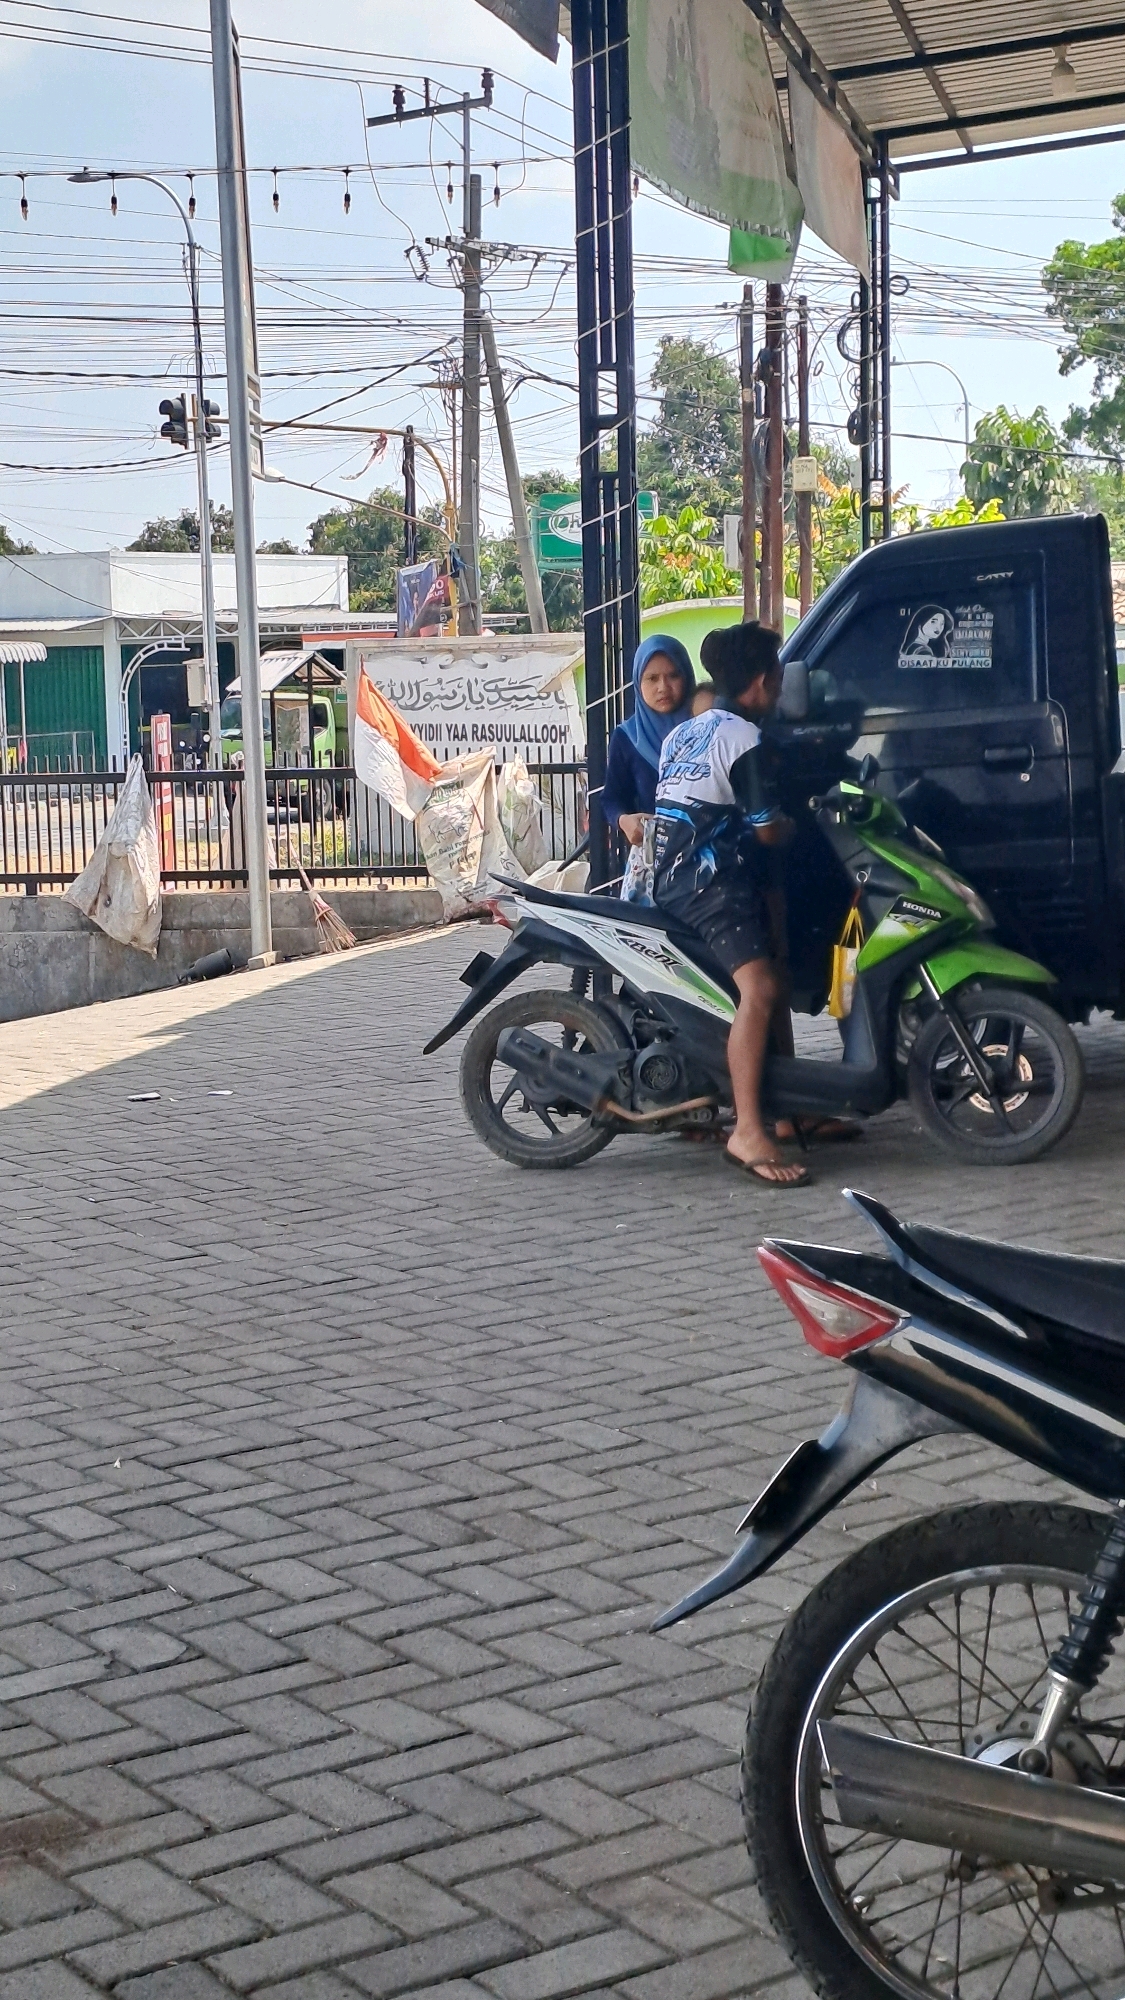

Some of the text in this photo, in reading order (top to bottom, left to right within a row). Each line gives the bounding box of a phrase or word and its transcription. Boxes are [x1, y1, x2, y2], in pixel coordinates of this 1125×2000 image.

[951, 659, 990, 668] PULANG
[445, 723, 469, 742] YAA
[902, 900, 942, 919] HONDA
